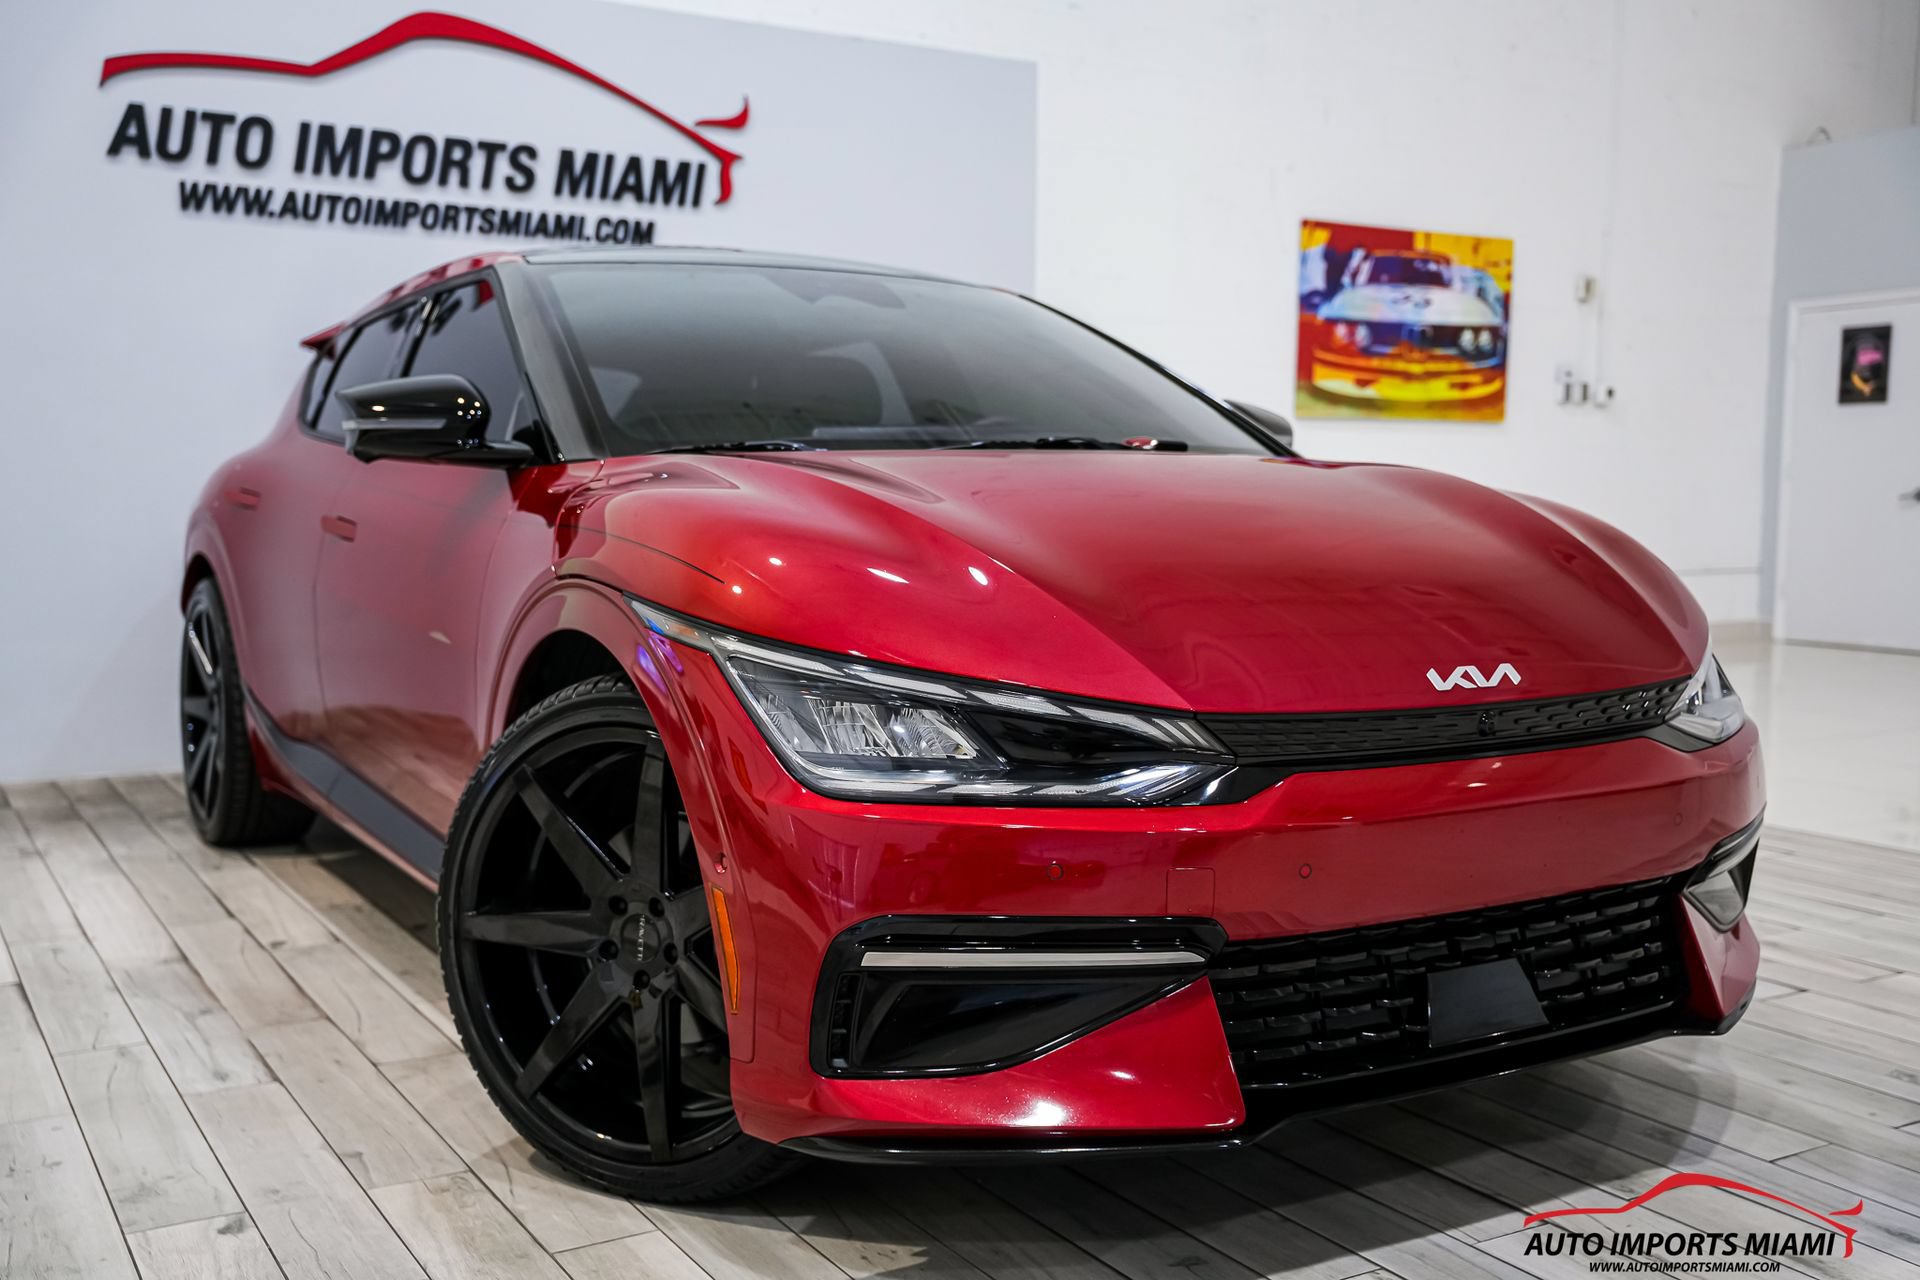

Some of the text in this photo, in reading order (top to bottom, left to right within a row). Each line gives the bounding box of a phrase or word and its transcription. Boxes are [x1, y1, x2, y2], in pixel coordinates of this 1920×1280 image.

[107, 102, 706, 208] AUTO IMPORTS MIAMI
[179, 180, 655, 245] WWW.AUTOIMPORTSMIAMI.COM
